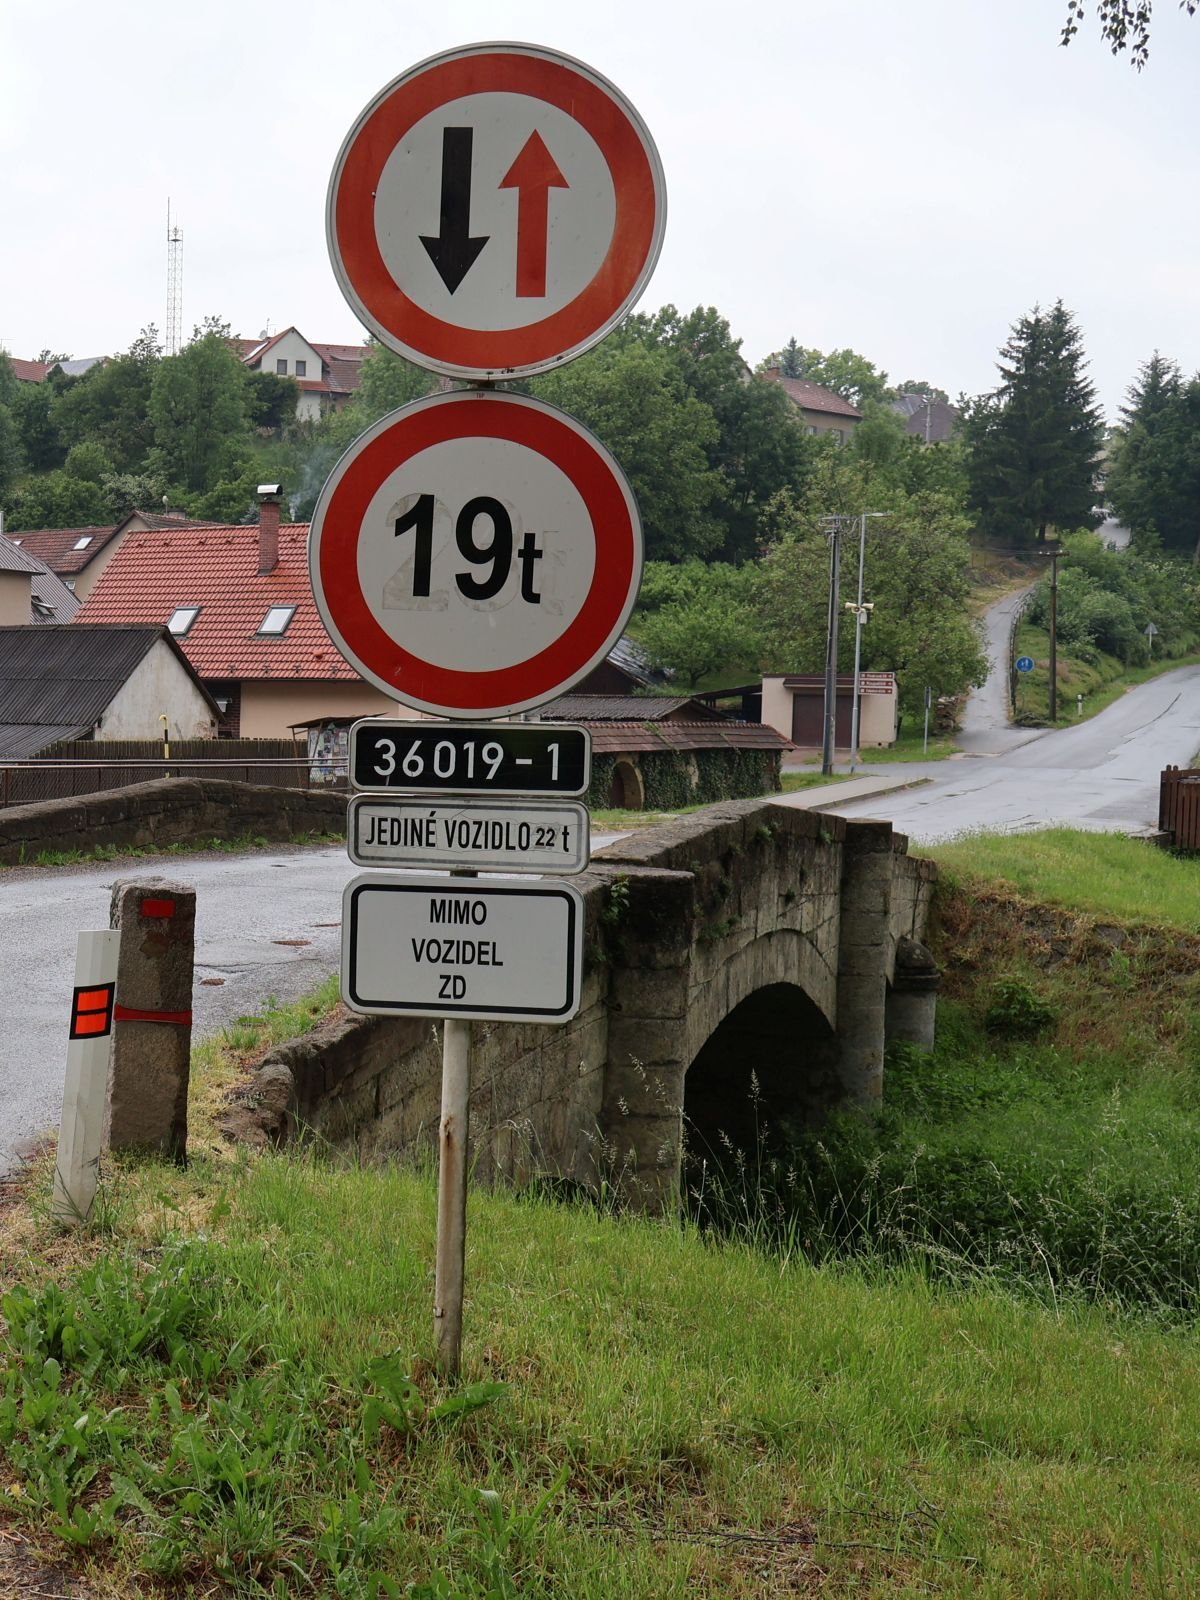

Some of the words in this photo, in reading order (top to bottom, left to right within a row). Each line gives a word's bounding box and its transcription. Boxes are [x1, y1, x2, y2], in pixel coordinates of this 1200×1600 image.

[365, 810, 437, 848] JEDINÉ
[444, 819, 531, 851] VOZIDLO
[429, 898, 487, 926] MIMO
[411, 937, 504, 967] VOZIDEL
[438, 974, 467, 1000] ZD
